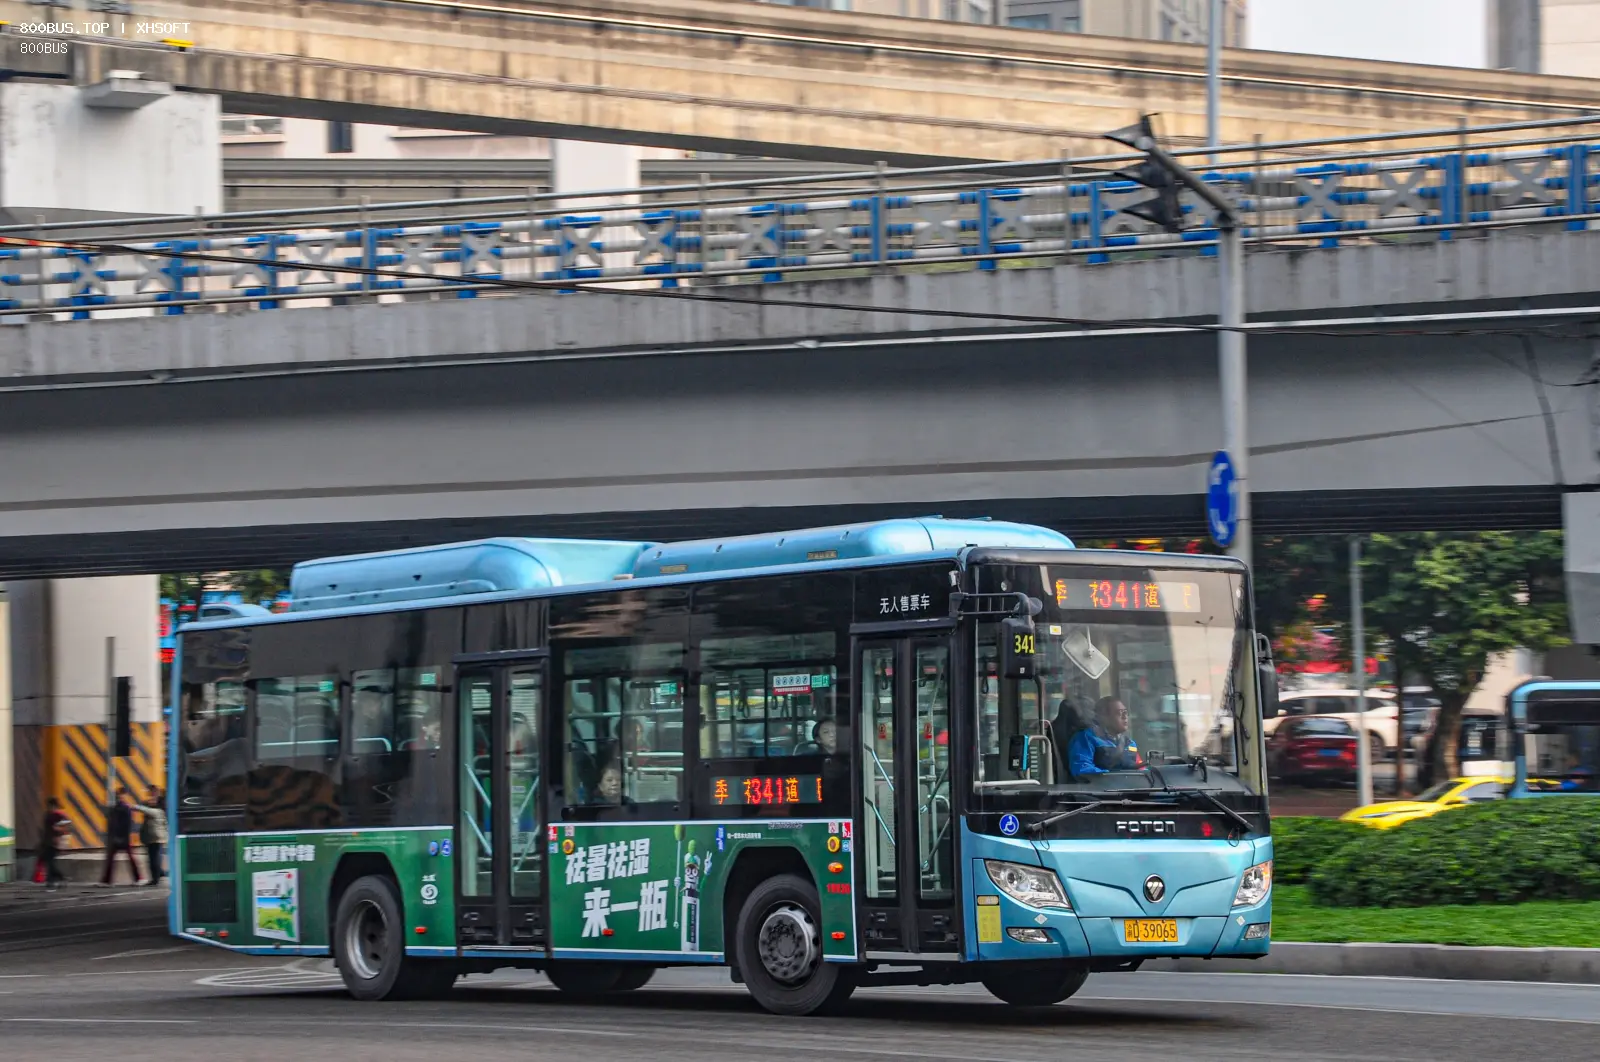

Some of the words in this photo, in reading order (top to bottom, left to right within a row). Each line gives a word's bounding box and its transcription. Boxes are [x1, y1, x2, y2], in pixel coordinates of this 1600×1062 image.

[880, 593, 930, 614] 无人售票车
[1014, 634, 1035, 654] 341
[1116, 820, 1176, 834] FOTON
[565, 838, 650, 885] 祛暑祛湿
[581, 879, 669, 938] 来一瓶
